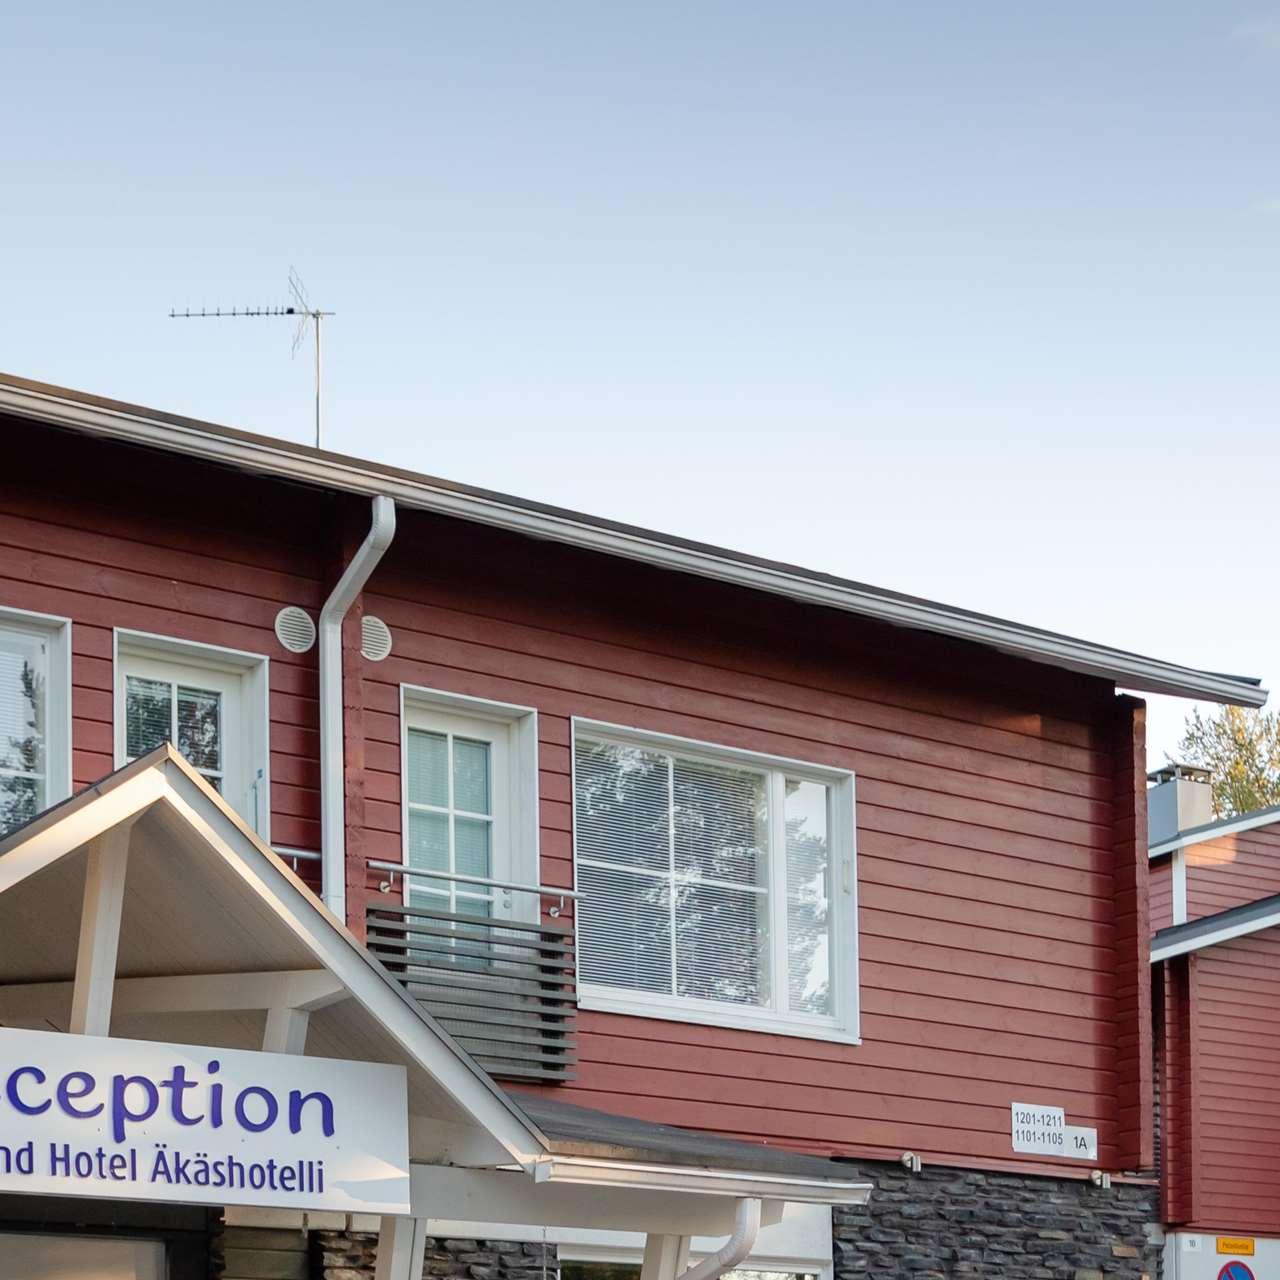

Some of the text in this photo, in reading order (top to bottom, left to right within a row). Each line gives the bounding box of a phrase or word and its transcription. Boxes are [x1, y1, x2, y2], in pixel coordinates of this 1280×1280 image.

[1015, 1111, 1063, 1128] 1201-1211
[1015, 1129, 1063, 1145] 1101-1105
[1073, 1135, 1088, 1151] 1A
[49, 1142, 138, 1182] Hotel
[150, 1143, 324, 1194] Äkäshotelli
